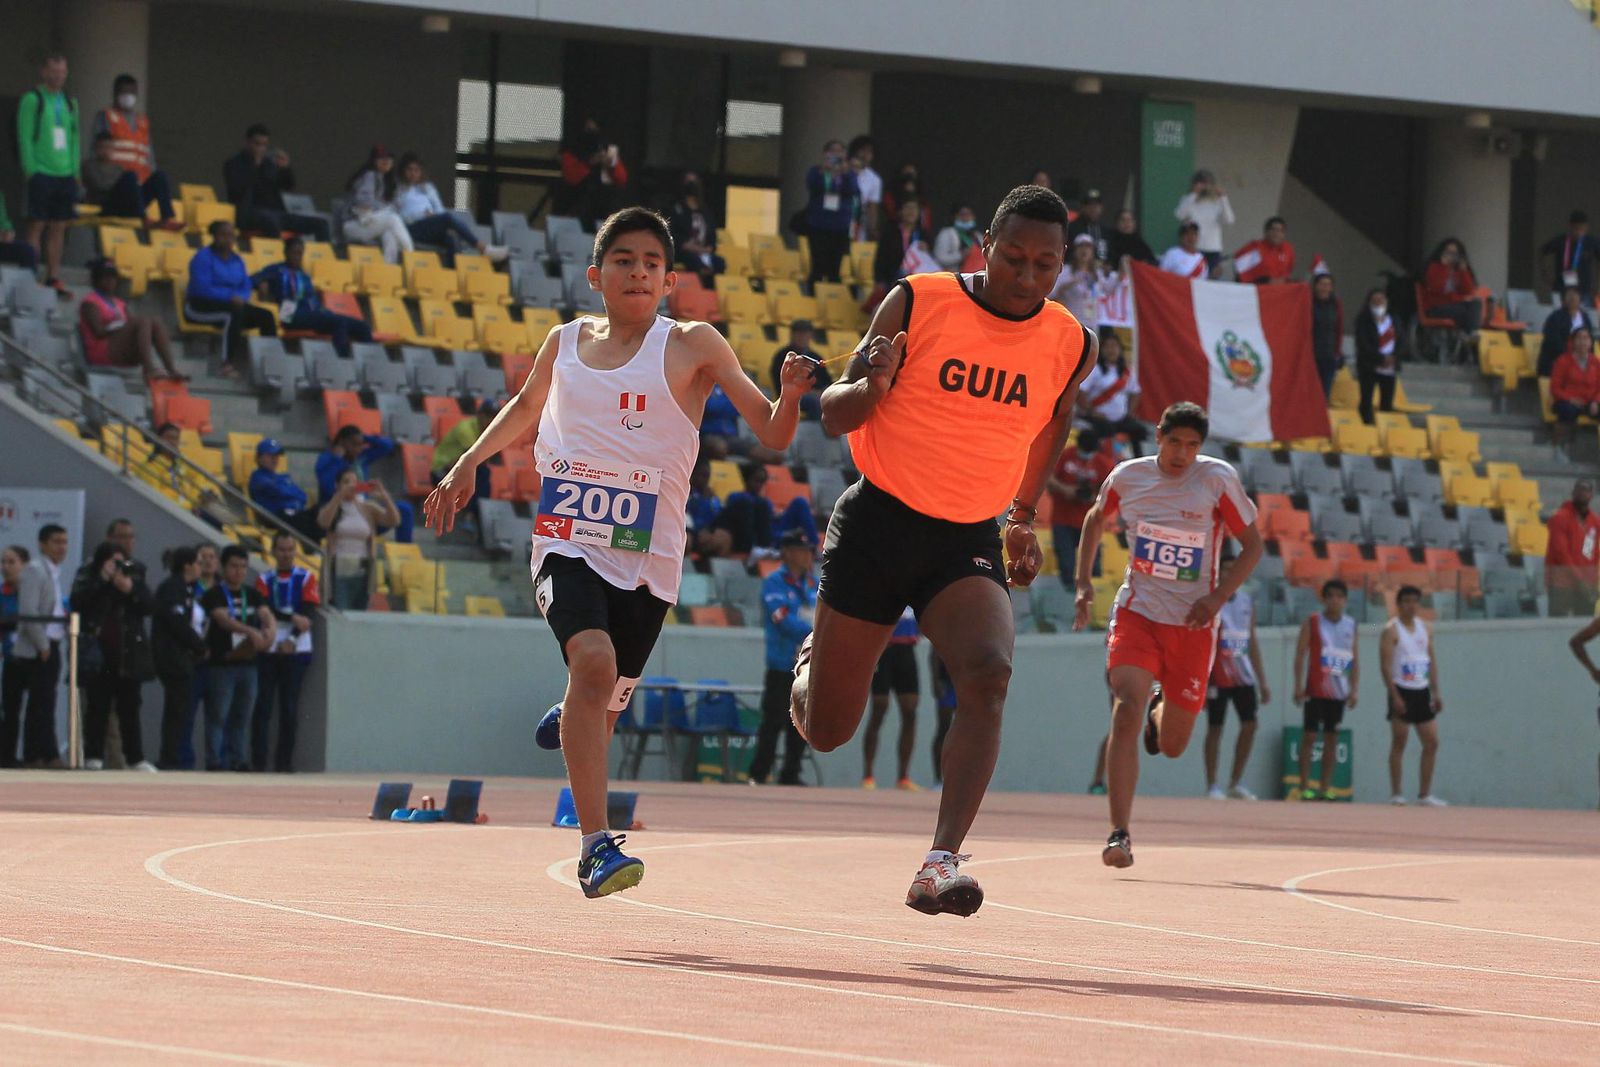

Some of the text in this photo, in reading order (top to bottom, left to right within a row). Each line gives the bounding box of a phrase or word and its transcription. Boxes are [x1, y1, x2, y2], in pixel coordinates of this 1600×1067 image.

[939, 358, 1028, 408] GUIA
[587, 469, 619, 478] ATLETISMO
[552, 483, 640, 526] 200
[1144, 541, 1194, 568] 165
[539, 591, 546, 607] 5
[619, 687, 632, 703] 5
